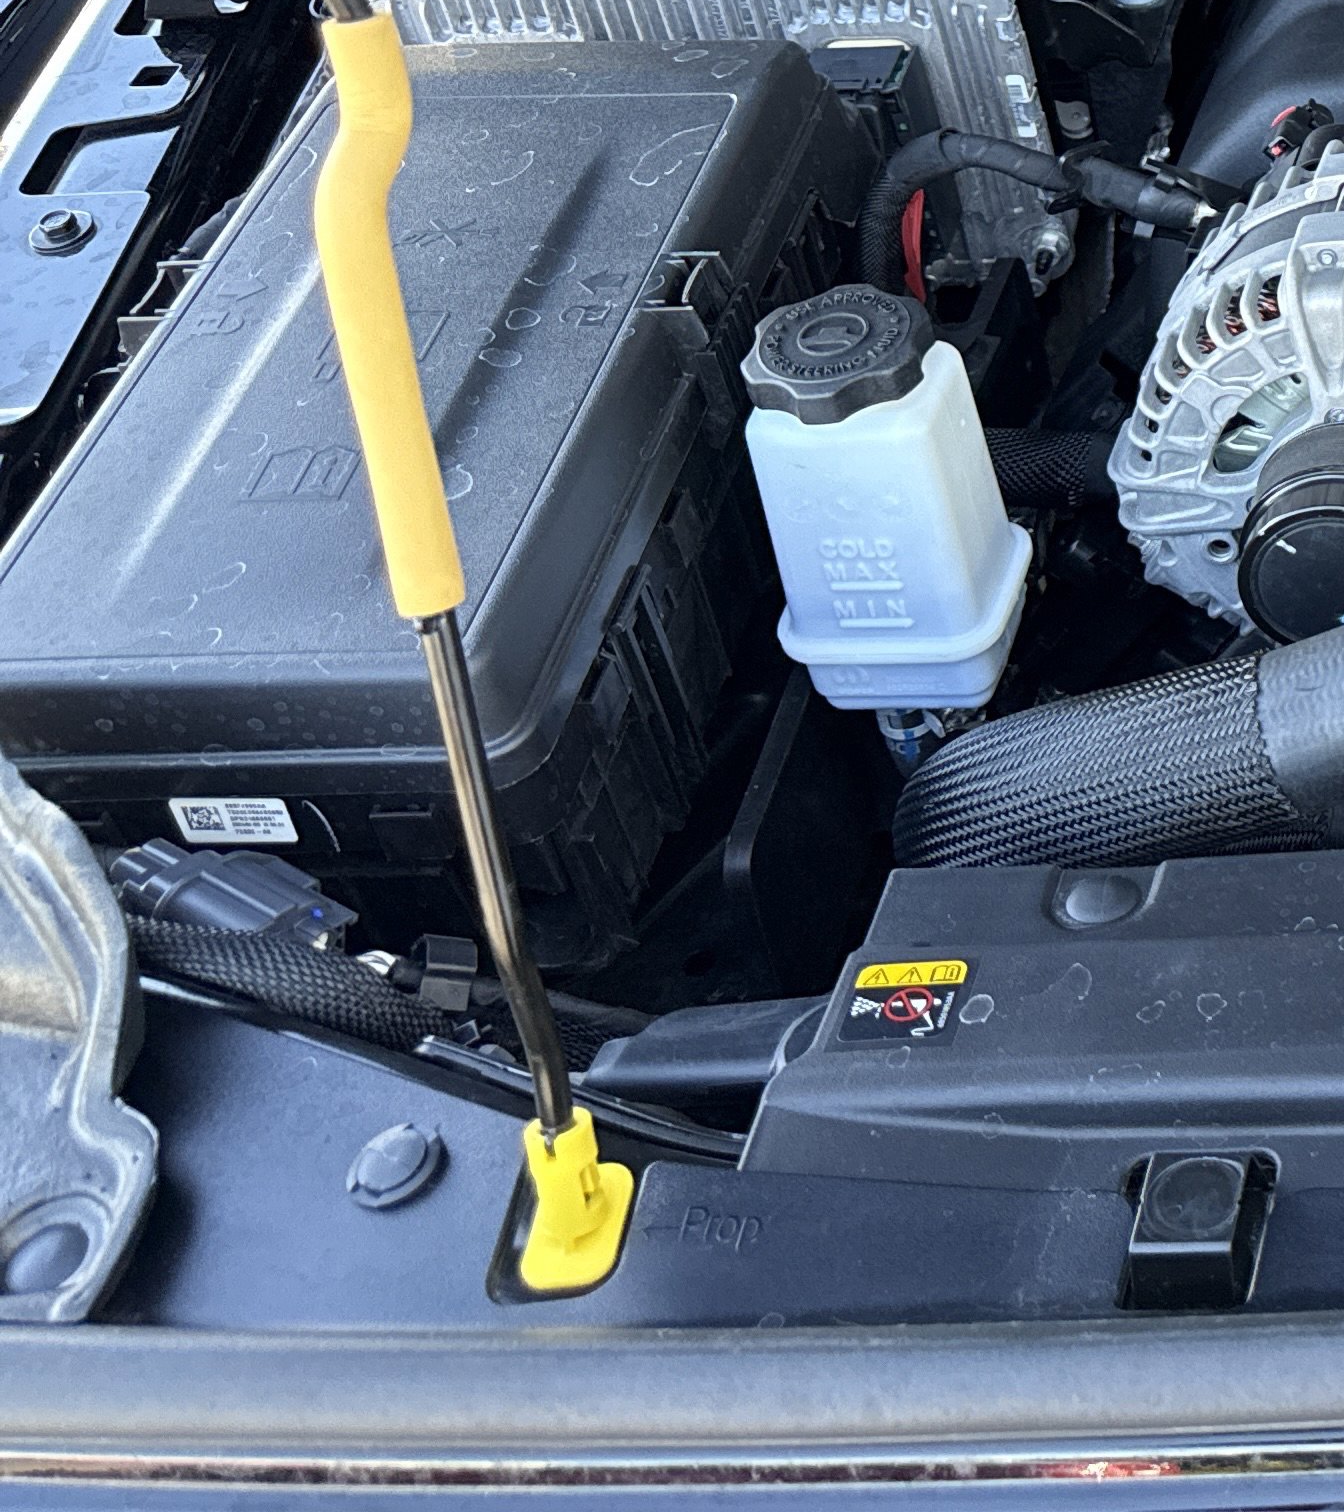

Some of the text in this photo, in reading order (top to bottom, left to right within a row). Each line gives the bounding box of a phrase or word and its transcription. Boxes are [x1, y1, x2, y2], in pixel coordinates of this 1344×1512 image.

[819, 538, 895, 559] COLD
[824, 561, 900, 581] MAX
[833, 599, 908, 618] MIN
[678, 1205, 761, 1253] Prop
